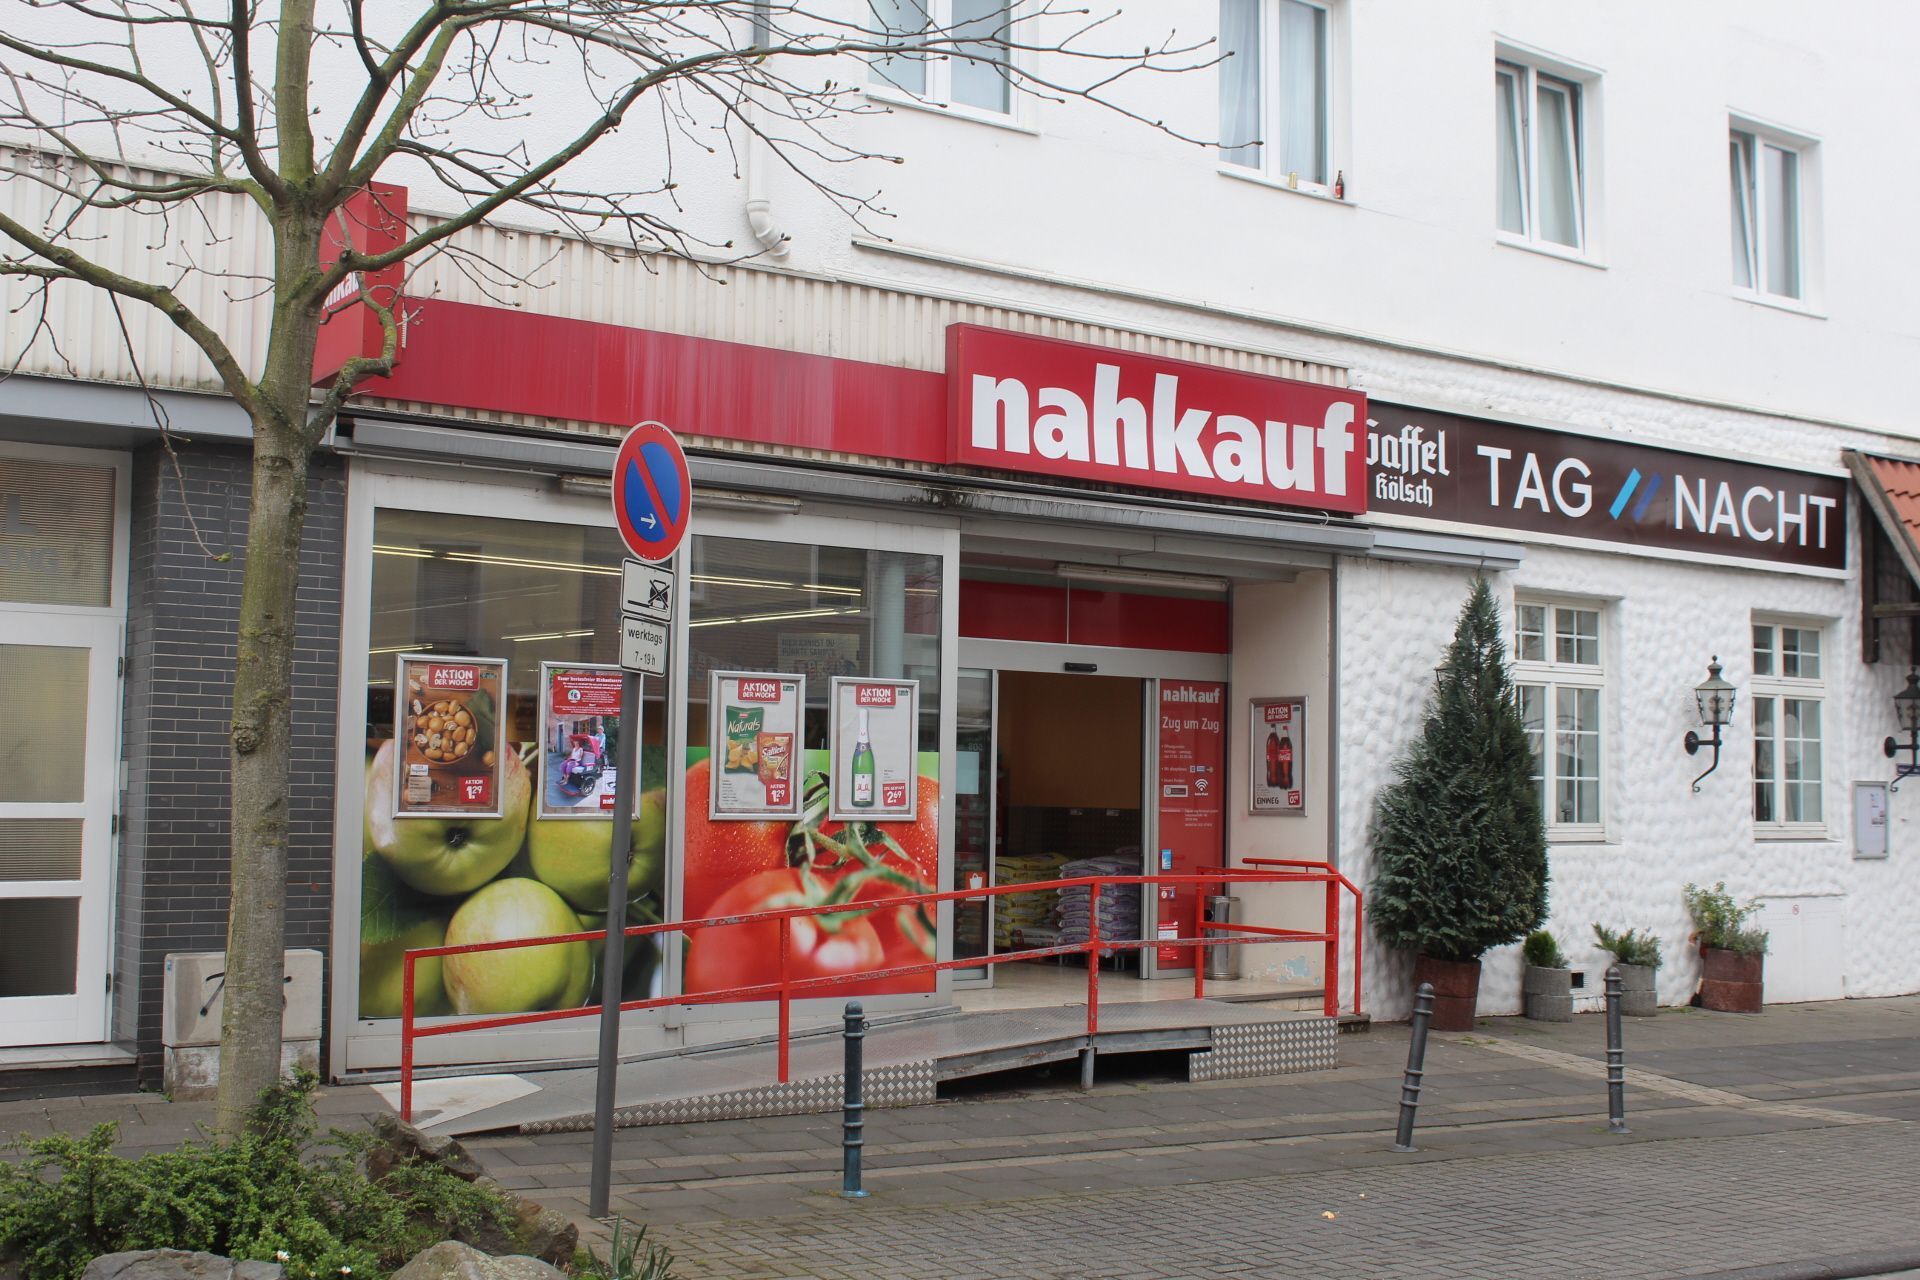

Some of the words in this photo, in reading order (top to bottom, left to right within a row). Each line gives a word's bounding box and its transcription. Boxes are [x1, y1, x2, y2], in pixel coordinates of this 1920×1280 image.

[971, 362, 1355, 497] nahkauf
[1375, 472, 1433, 507] Kölsch
[1476, 445, 1593, 518] TAG
[1674, 474, 1837, 549] NACHT
[627, 628, 663, 646] werktags
[635, 651, 639, 662] 7
[434, 669, 473, 680] AKTION
[448, 679, 473, 687] WOCHE
[743, 682, 776, 692] AKTION
[861, 688, 891, 697] AKTION
[1163, 686, 1220, 704] nahkauf
[1267, 706, 1289, 715] AKTION
[727, 718, 761, 734] Naturals
[1162, 716, 1181, 732] Zug
[1183, 720, 1199, 729] um
[1201, 718, 1220, 733] Zug
